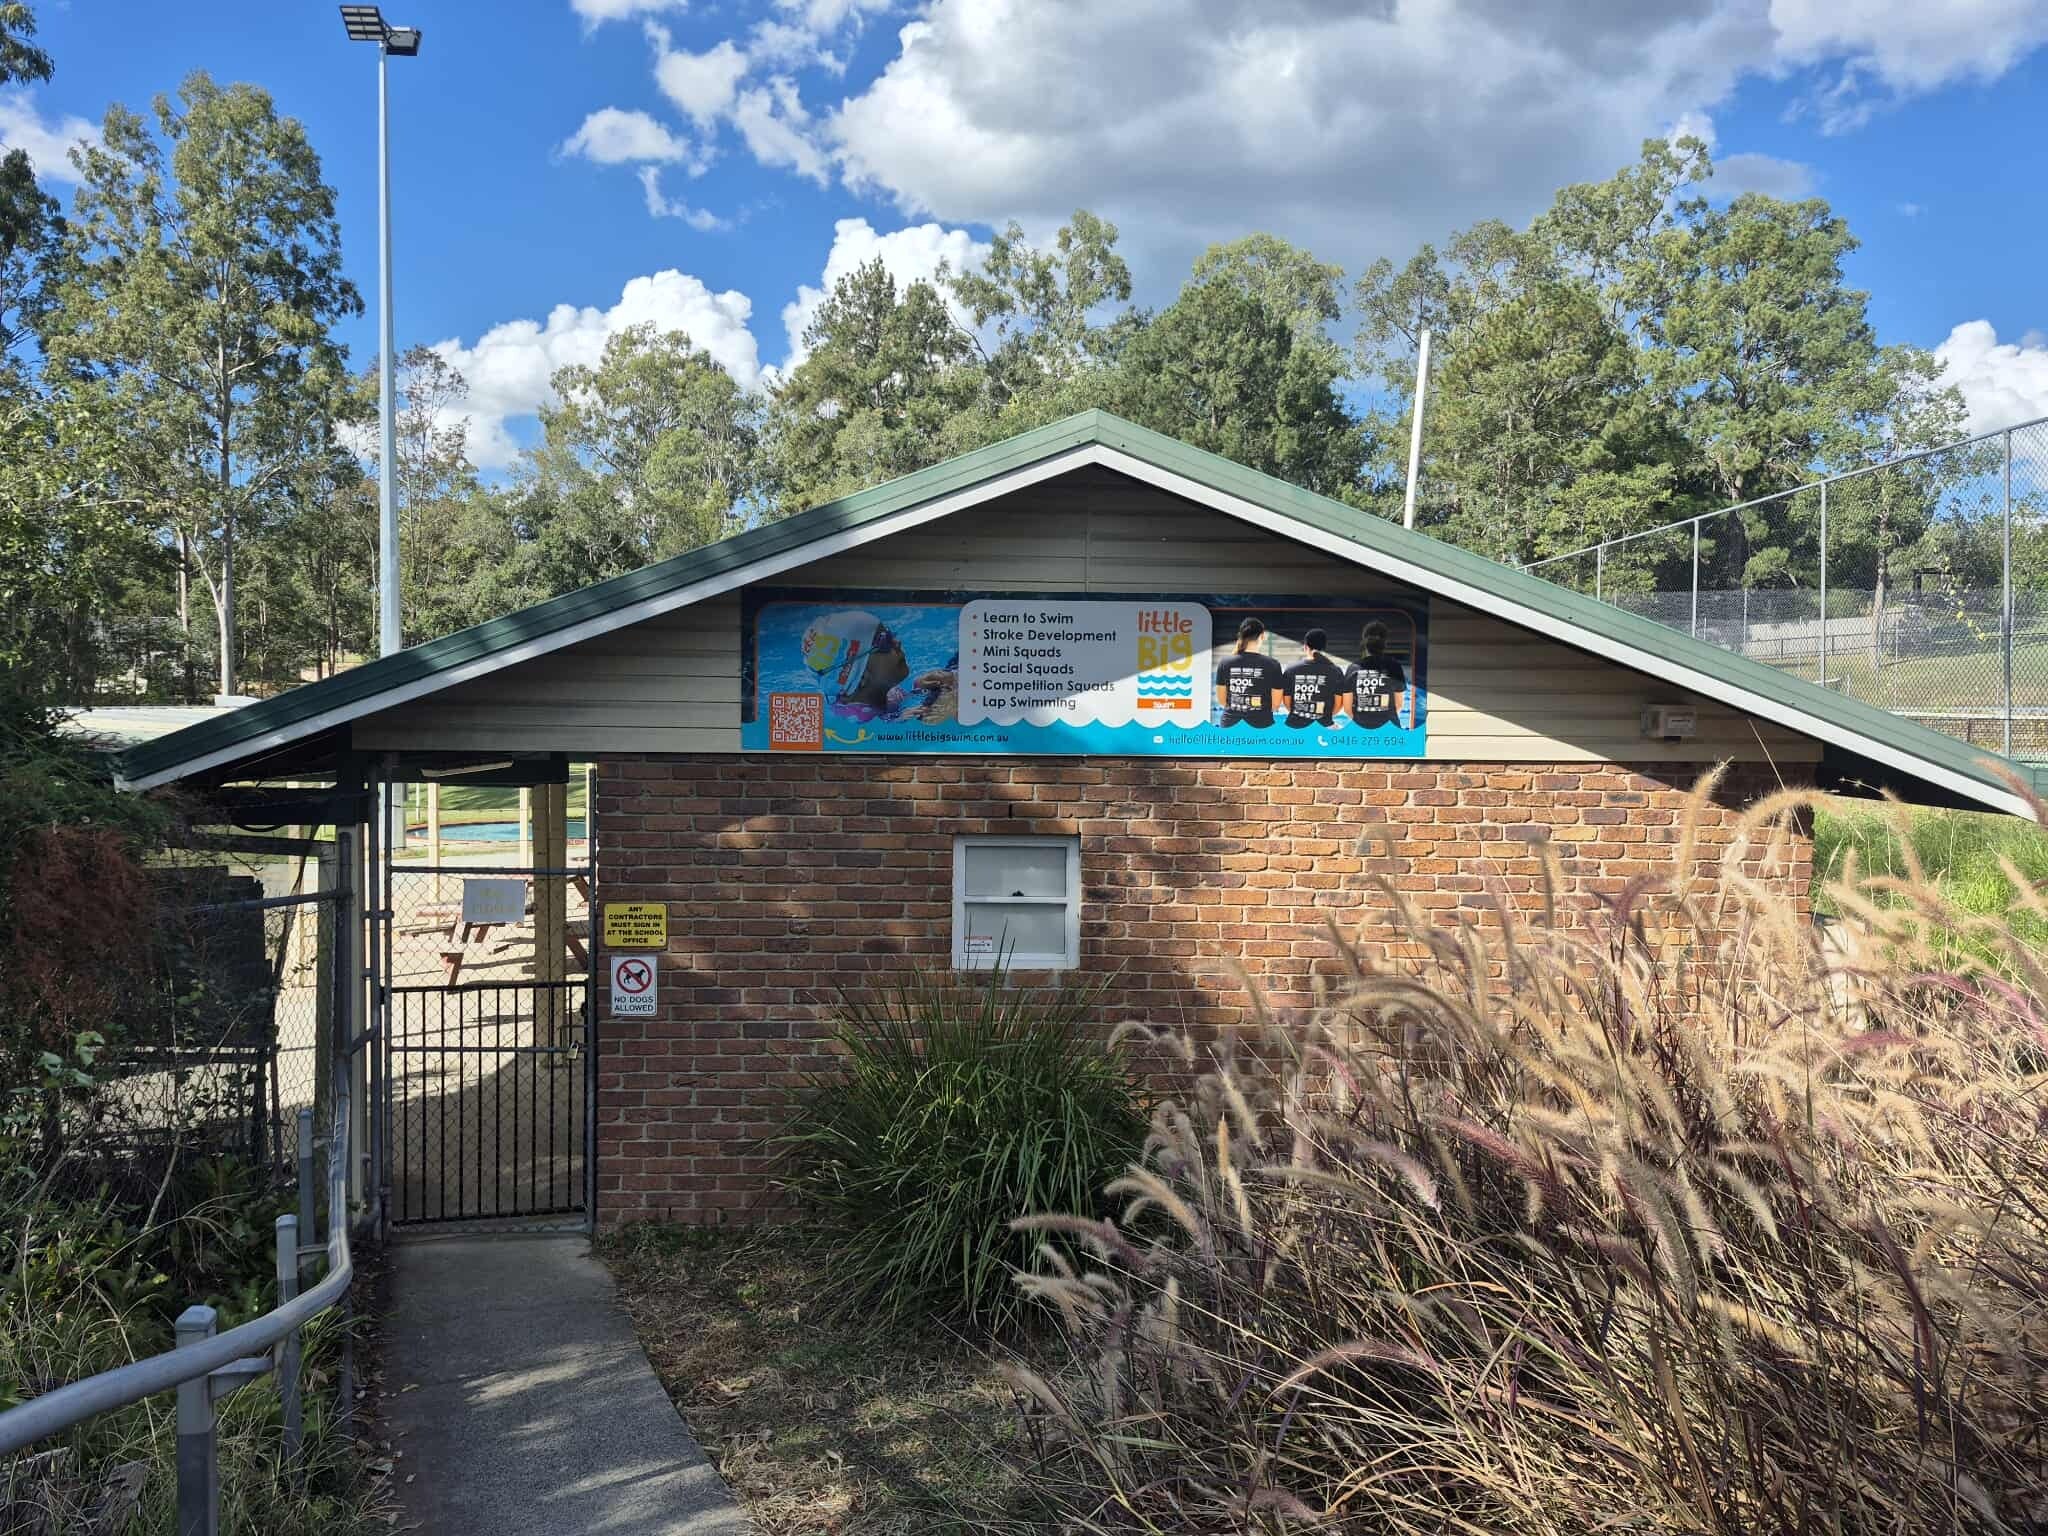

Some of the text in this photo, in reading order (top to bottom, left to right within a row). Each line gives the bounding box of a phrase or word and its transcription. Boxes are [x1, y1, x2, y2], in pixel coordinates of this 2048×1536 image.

[983, 612, 1074, 624] Learn to Swim
[1137, 609, 1193, 633] little
[983, 628, 1117, 643] Stroke Development
[983, 646, 1062, 660] Mini Squads
[1137, 634, 1193, 671] Big
[983, 662, 1074, 677] Social Squads
[983, 679, 1115, 694] Competition Squads
[1230, 678, 1254, 687] POOL
[1356, 678, 1385, 687] POOL
[1229, 686, 1247, 694] RAT
[1294, 684, 1321, 694] POOL
[1356, 686, 1377, 695] RAT
[983, 696, 1076, 710] Lap Swimming
[1294, 693, 1312, 702] RAT
[614, 996, 654, 1004] NO DOGS
[614, 1004, 654, 1012] ALLOWED
